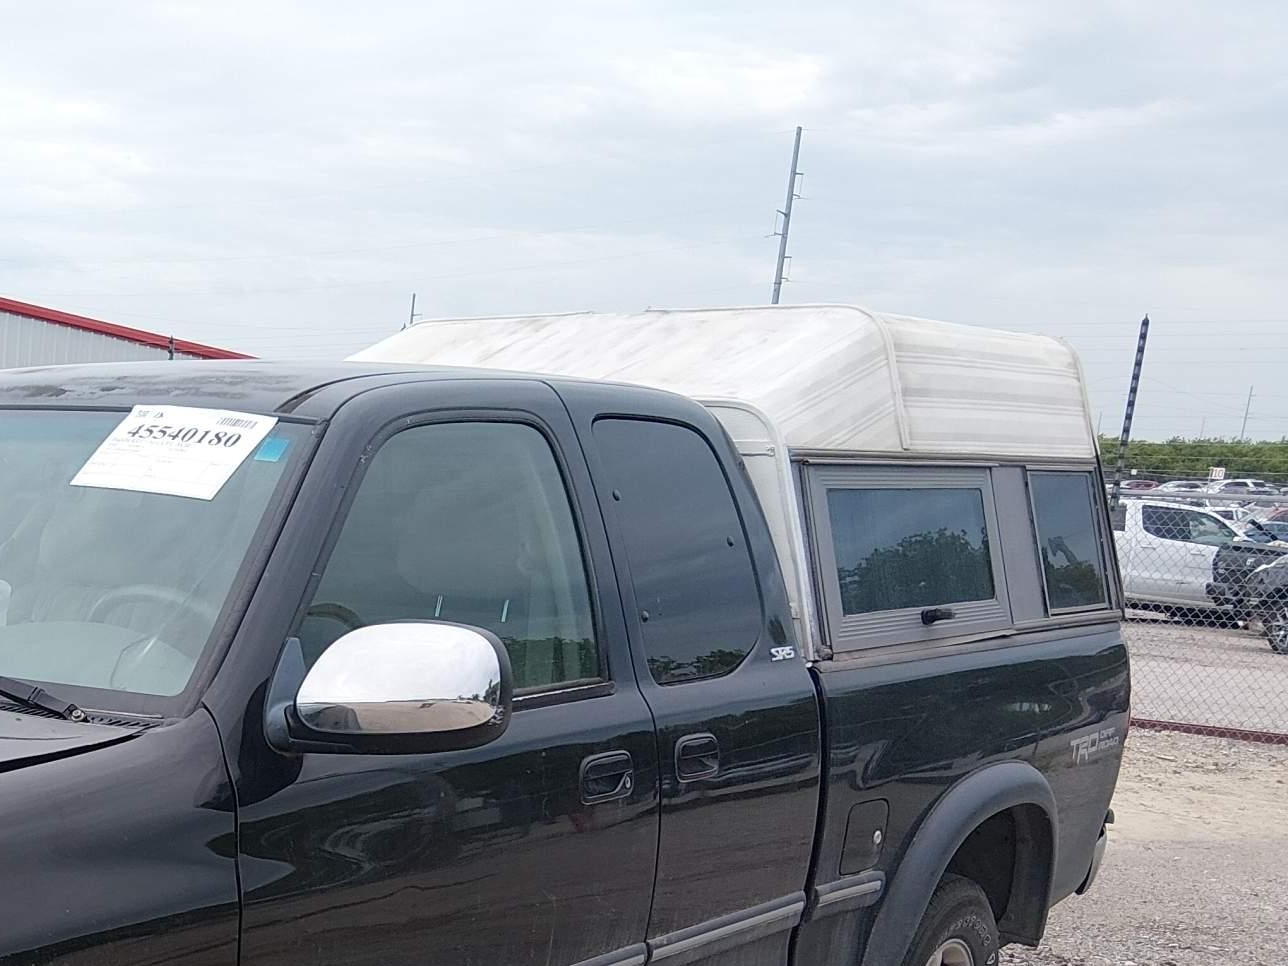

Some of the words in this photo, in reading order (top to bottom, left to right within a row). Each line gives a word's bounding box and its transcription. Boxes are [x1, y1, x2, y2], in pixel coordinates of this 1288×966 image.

[127, 423, 242, 448] 45540180
[770, 645, 795, 662] SR5
[1070, 732, 1100, 766] TRD
